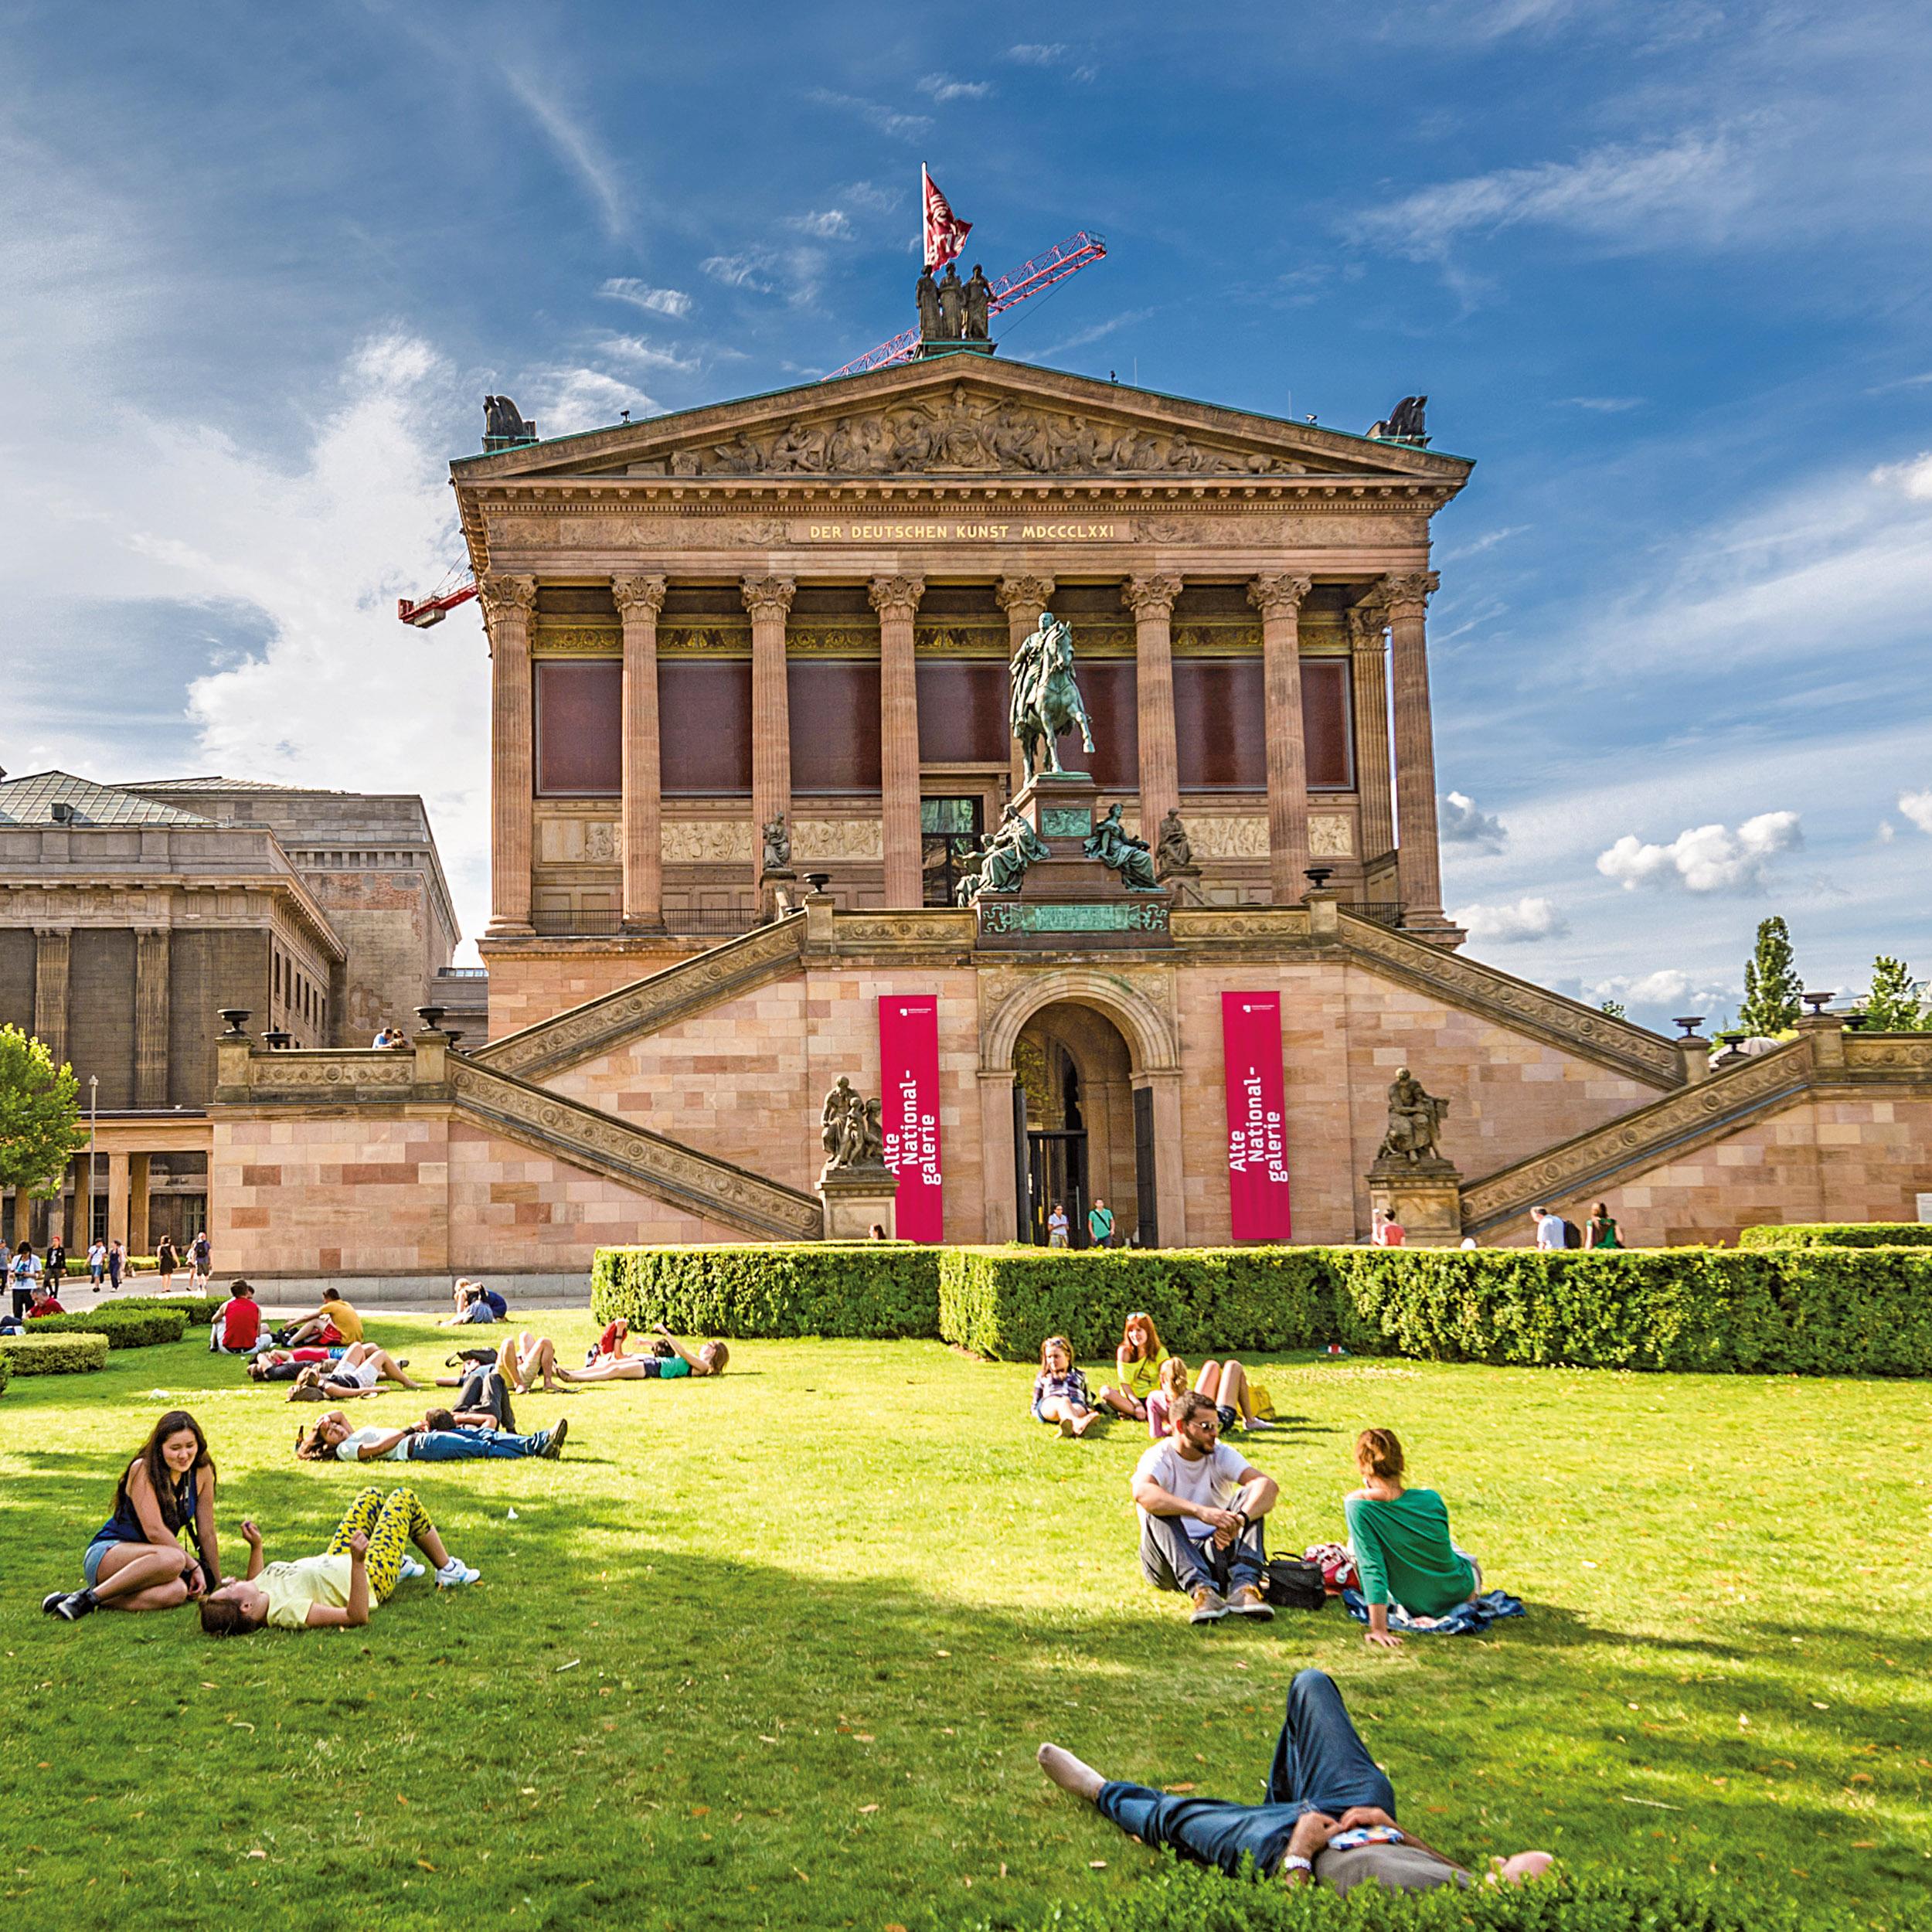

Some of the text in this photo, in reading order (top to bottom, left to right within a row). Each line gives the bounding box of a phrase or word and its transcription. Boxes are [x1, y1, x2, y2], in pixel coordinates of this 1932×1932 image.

[810, 526, 1114, 539] DER DEUTSCHEN KUNST MDCCCLXXI
[900, 1070, 919, 1165] National-
[918, 1114, 942, 1185] galerie
[1243, 1066, 1265, 1162] National-
[1263, 1111, 1288, 1182] galerie
[883, 1133, 900, 1175] Alte
[1229, 1130, 1247, 1172] Alte
